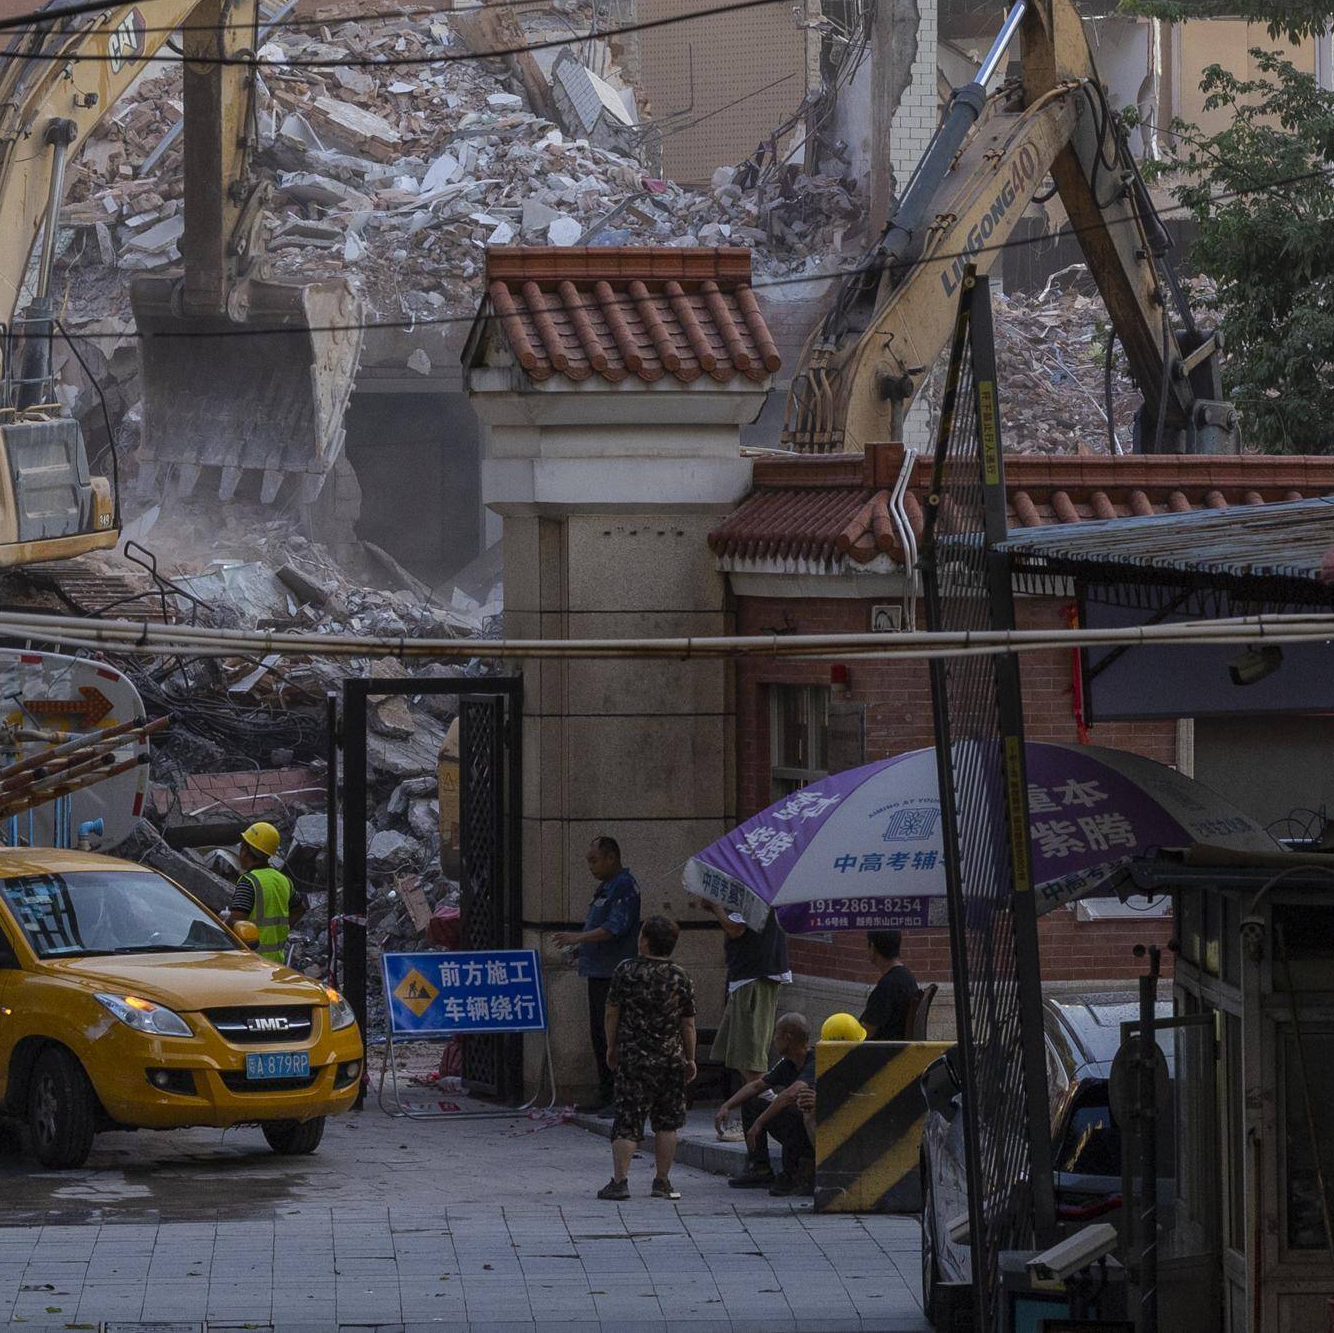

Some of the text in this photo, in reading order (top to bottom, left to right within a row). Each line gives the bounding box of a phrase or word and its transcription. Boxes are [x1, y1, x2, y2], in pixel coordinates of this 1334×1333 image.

[108, 11, 137, 72] CAT
[833, 849, 947, 874] 中高考辅
[809, 898, 921, 913] 191-2861-8254
[438, 960, 533, 987] 前方施工
[443, 994, 536, 1022] 车辆绕行
[248, 1017, 289, 1031] JMC
